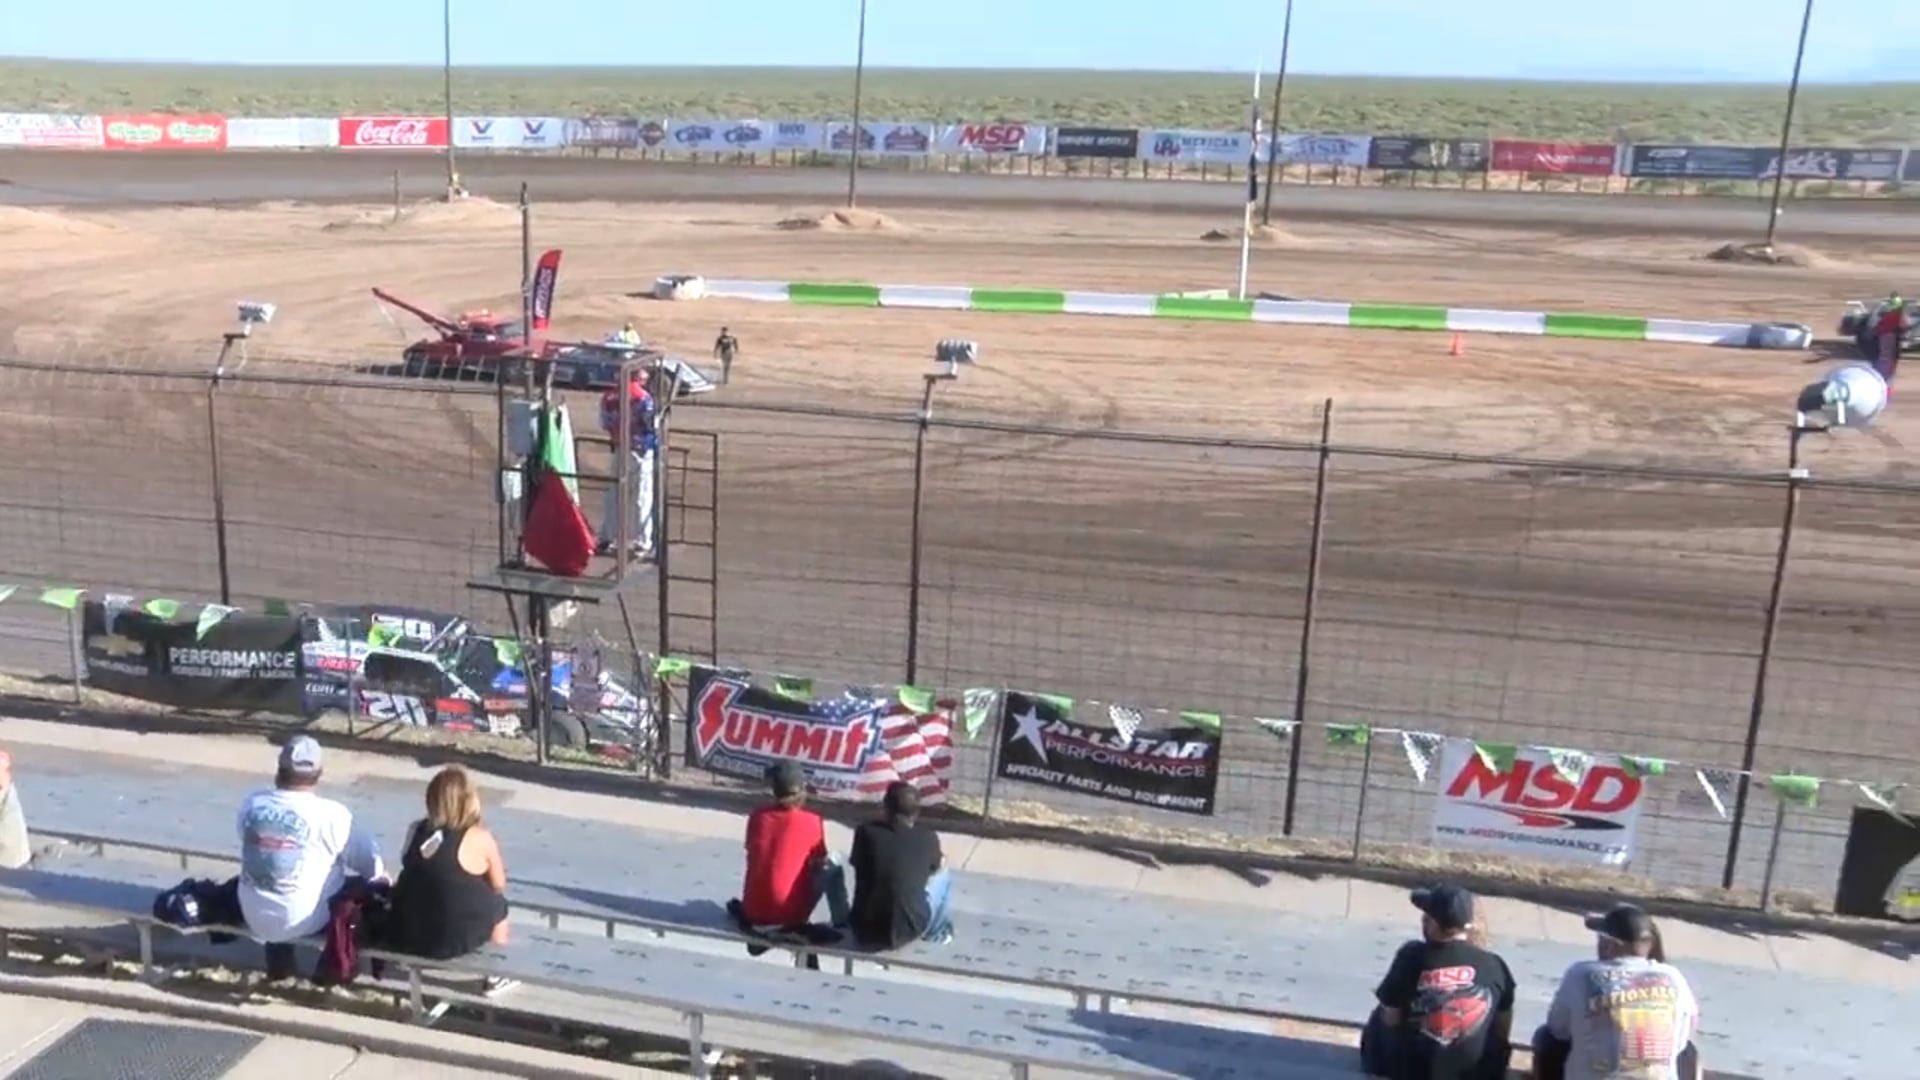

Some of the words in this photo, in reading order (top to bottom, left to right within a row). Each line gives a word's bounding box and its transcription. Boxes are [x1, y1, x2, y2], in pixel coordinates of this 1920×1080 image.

[958, 125, 1026, 145] MSD
[168, 647, 296, 669] PERFORMANCE
[1044, 719, 1209, 760] ALLSTAR
[1045, 740, 1206, 778] PERFORMANCE
[1005, 763, 1066, 784] SPECIALTY
[1066, 774, 1103, 792] PARTS
[1103, 783, 1133, 797] AND
[1446, 752, 1642, 813] MSD
[1420, 967, 1474, 987] MSD
